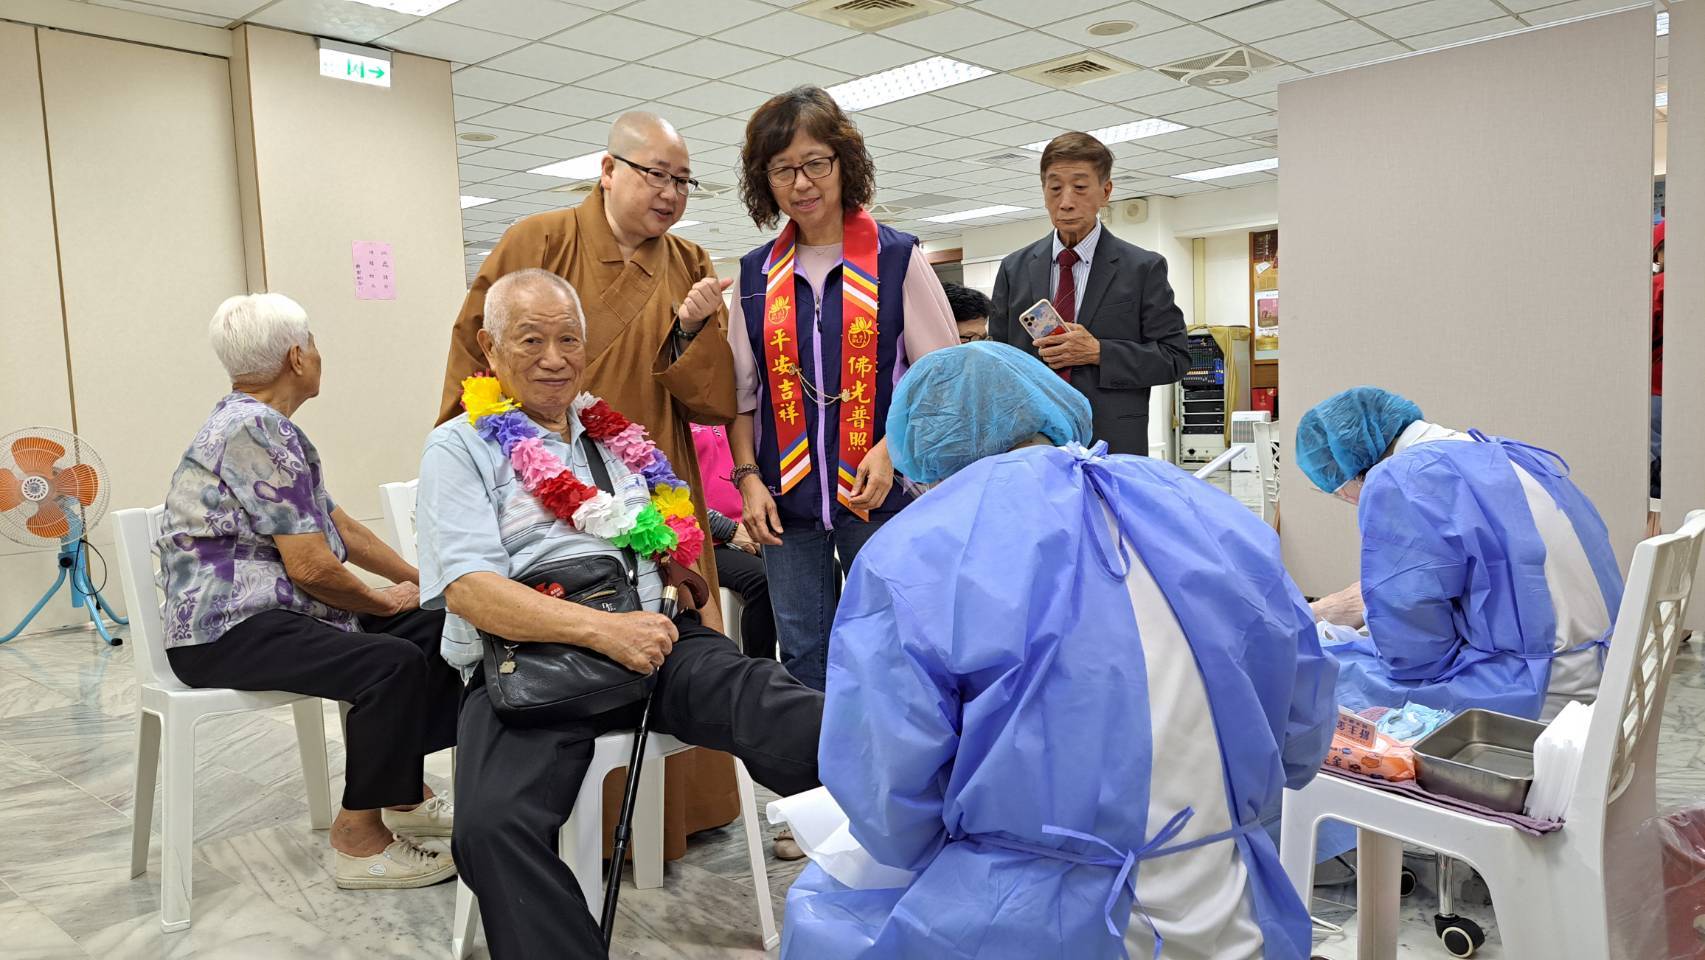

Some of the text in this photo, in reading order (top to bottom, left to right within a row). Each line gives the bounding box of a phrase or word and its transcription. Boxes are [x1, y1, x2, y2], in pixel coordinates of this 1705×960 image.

[770, 328, 800, 426] 平安吉祥
[846, 355, 873, 453] 佛光普照
